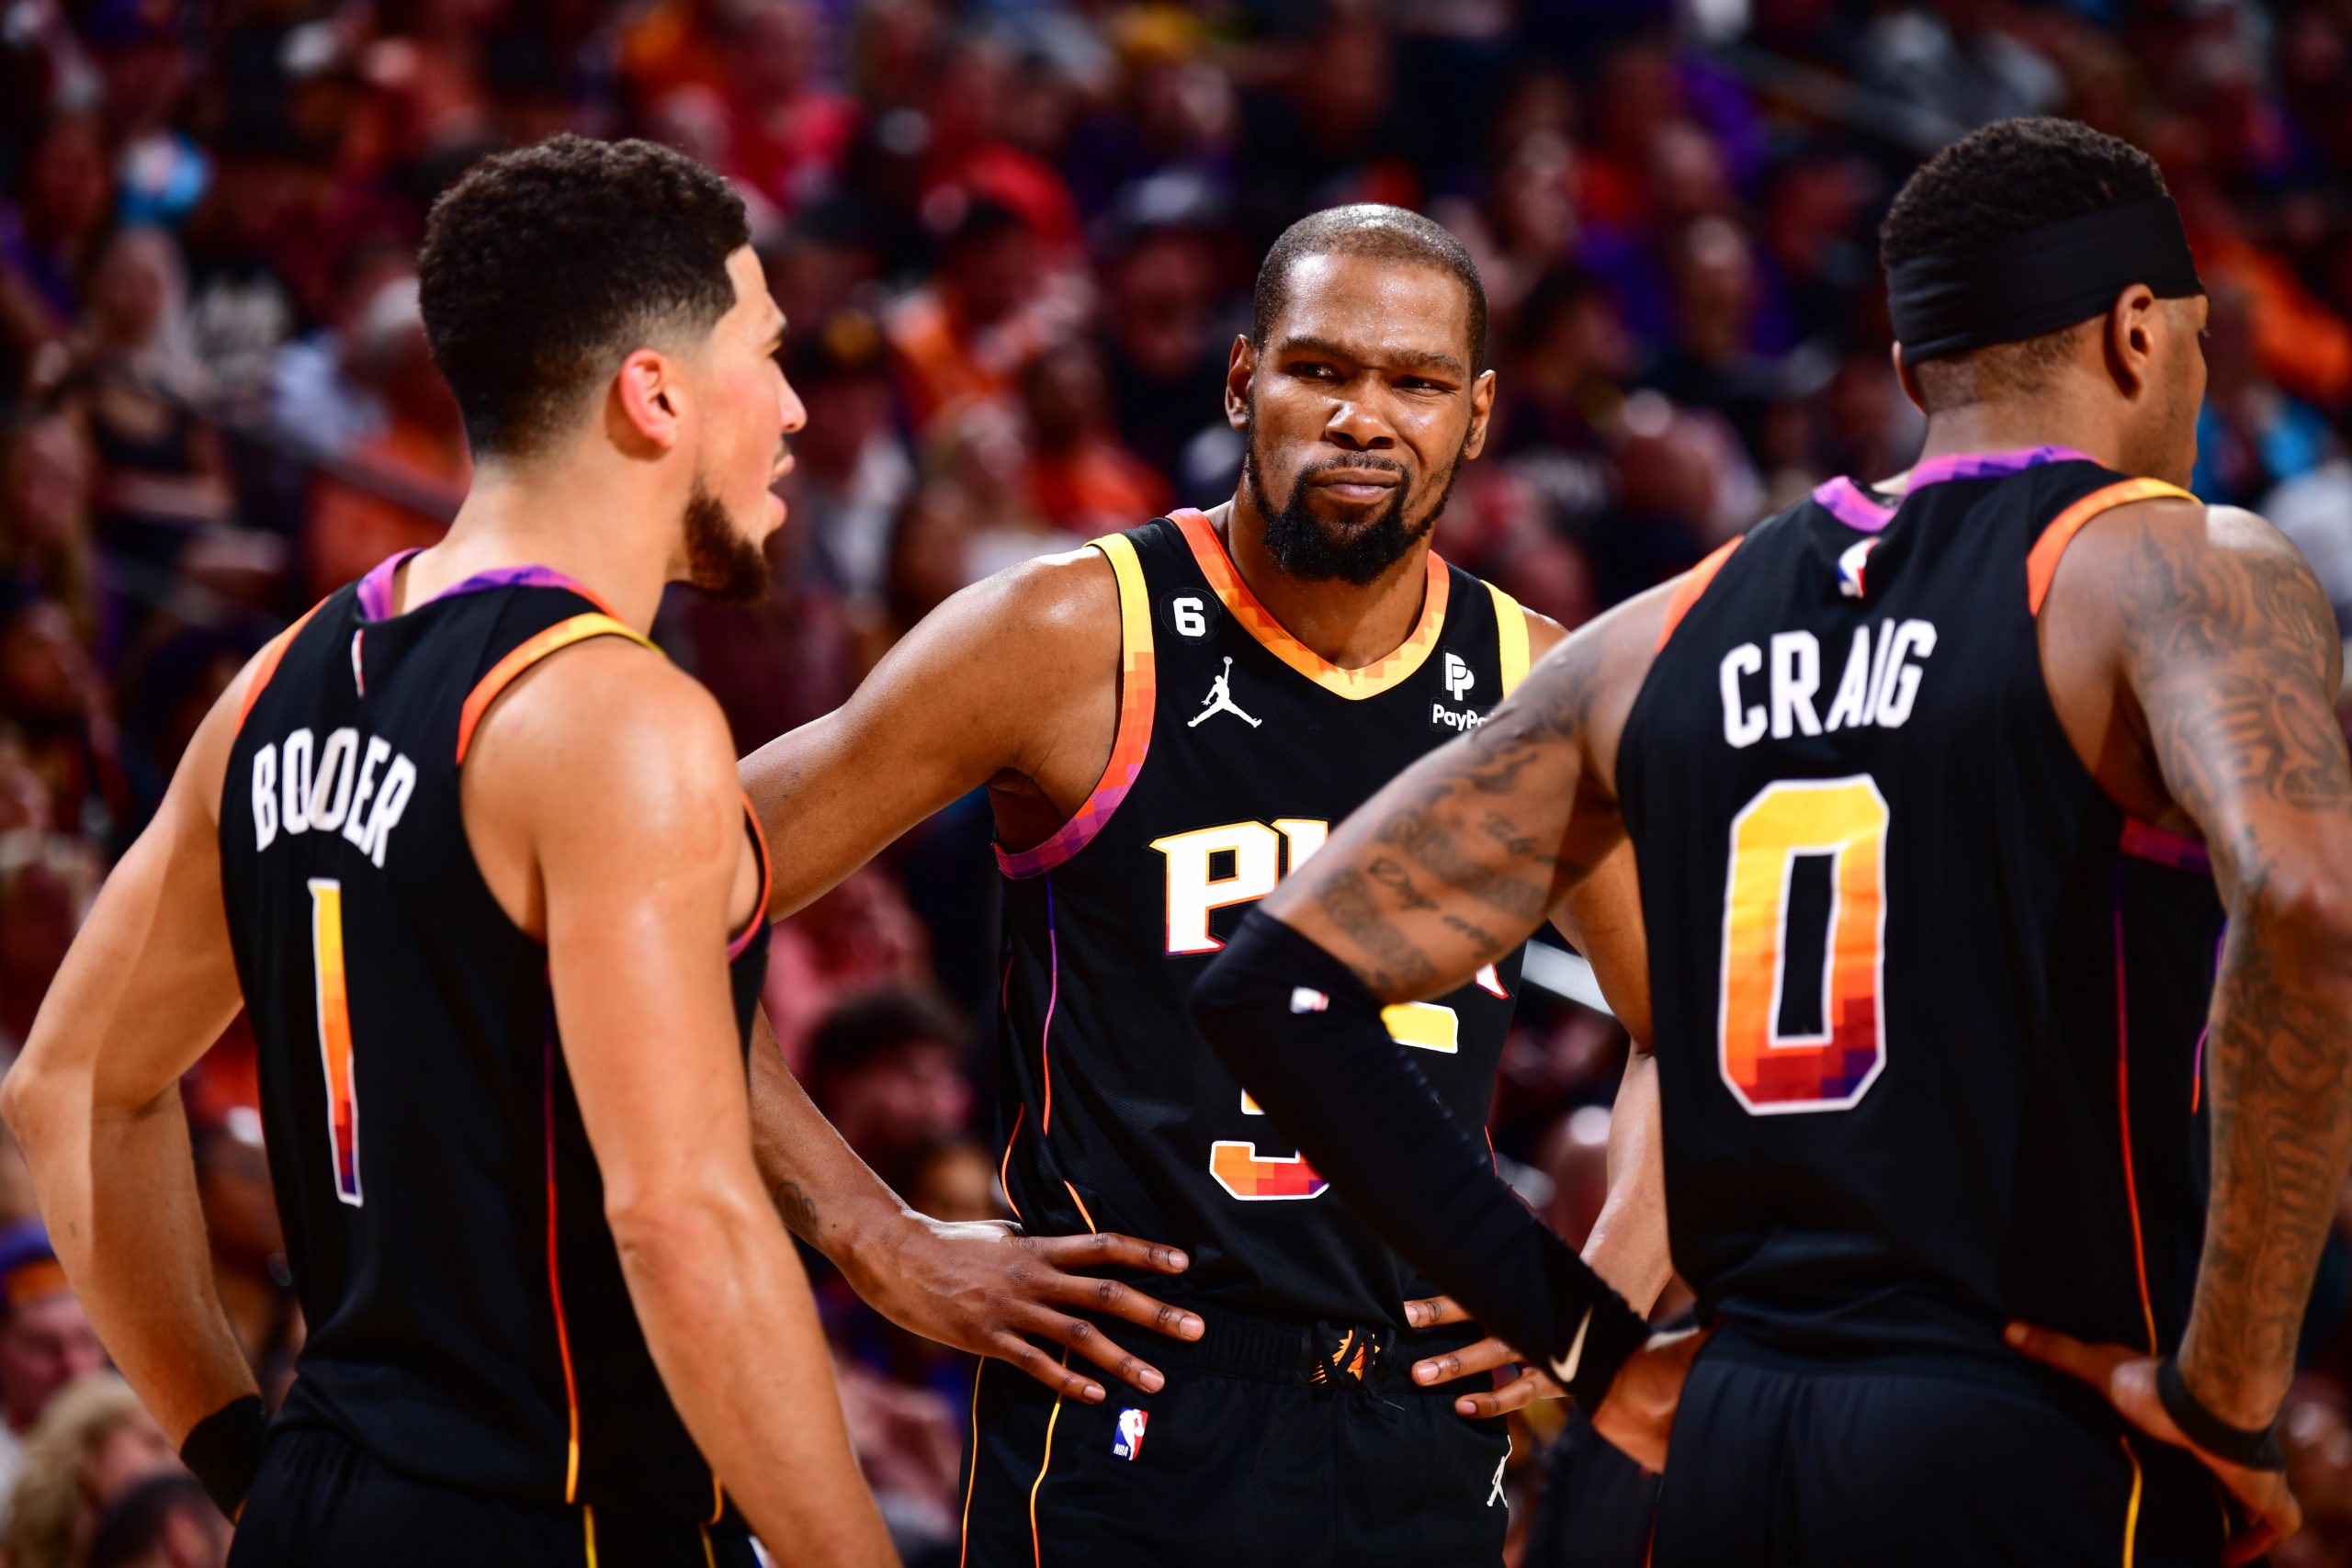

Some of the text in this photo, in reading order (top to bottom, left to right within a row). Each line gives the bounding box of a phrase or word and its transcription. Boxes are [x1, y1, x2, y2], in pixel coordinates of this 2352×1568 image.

[1173, 597, 1206, 637] 6
[1432, 704, 1494, 731] PayP
[1720, 617, 1938, 749] CRAIG
[1718, 773, 1890, 1115] 0
[307, 878, 364, 1207] 1
[1113, 1443, 1129, 1457] NBA
